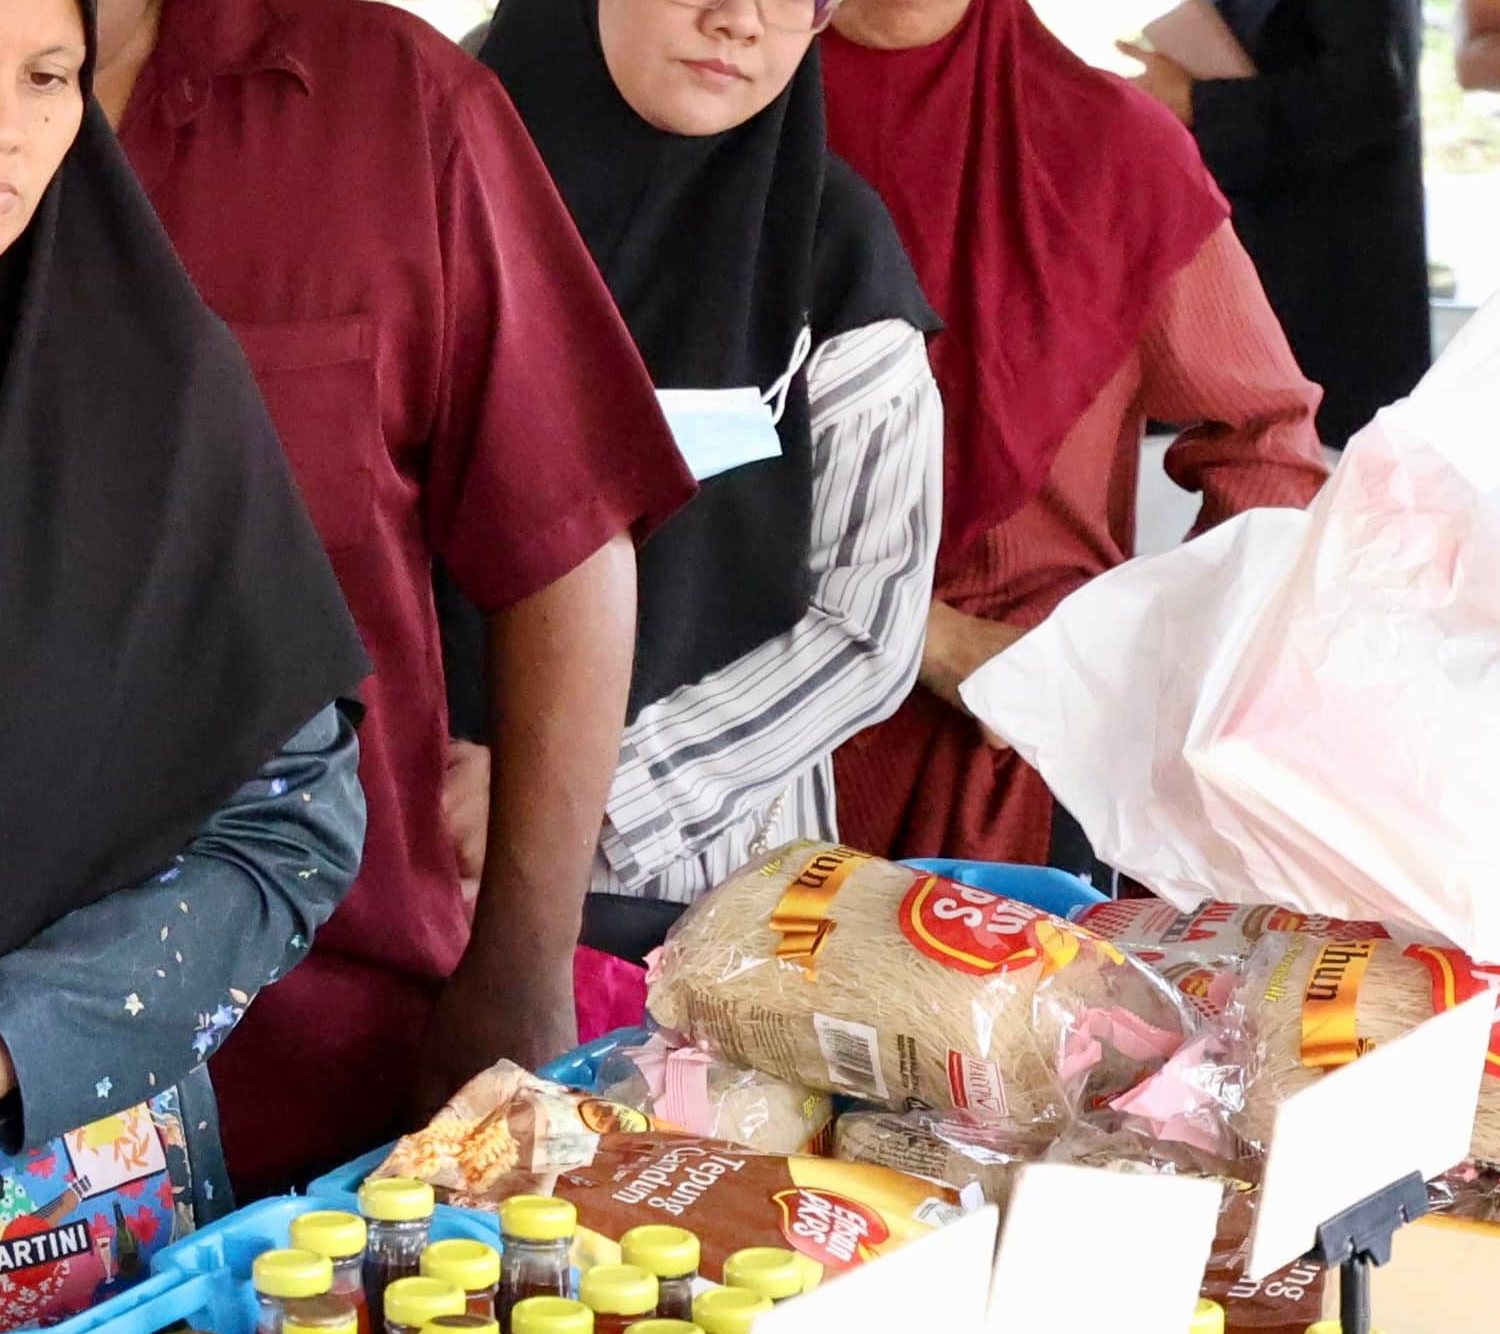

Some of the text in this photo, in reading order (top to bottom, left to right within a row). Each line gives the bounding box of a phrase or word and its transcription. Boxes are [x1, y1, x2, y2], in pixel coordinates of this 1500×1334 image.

[933, 883, 998, 927] PS
[1180, 900, 1240, 942] ULA
[1306, 937, 1368, 1003] ihun
[611, 1146, 706, 1204] Gandum
[647, 1154, 747, 1217] Tepung
[792, 1189, 833, 1244] PKPS
[825, 1204, 869, 1263] Ehsan
